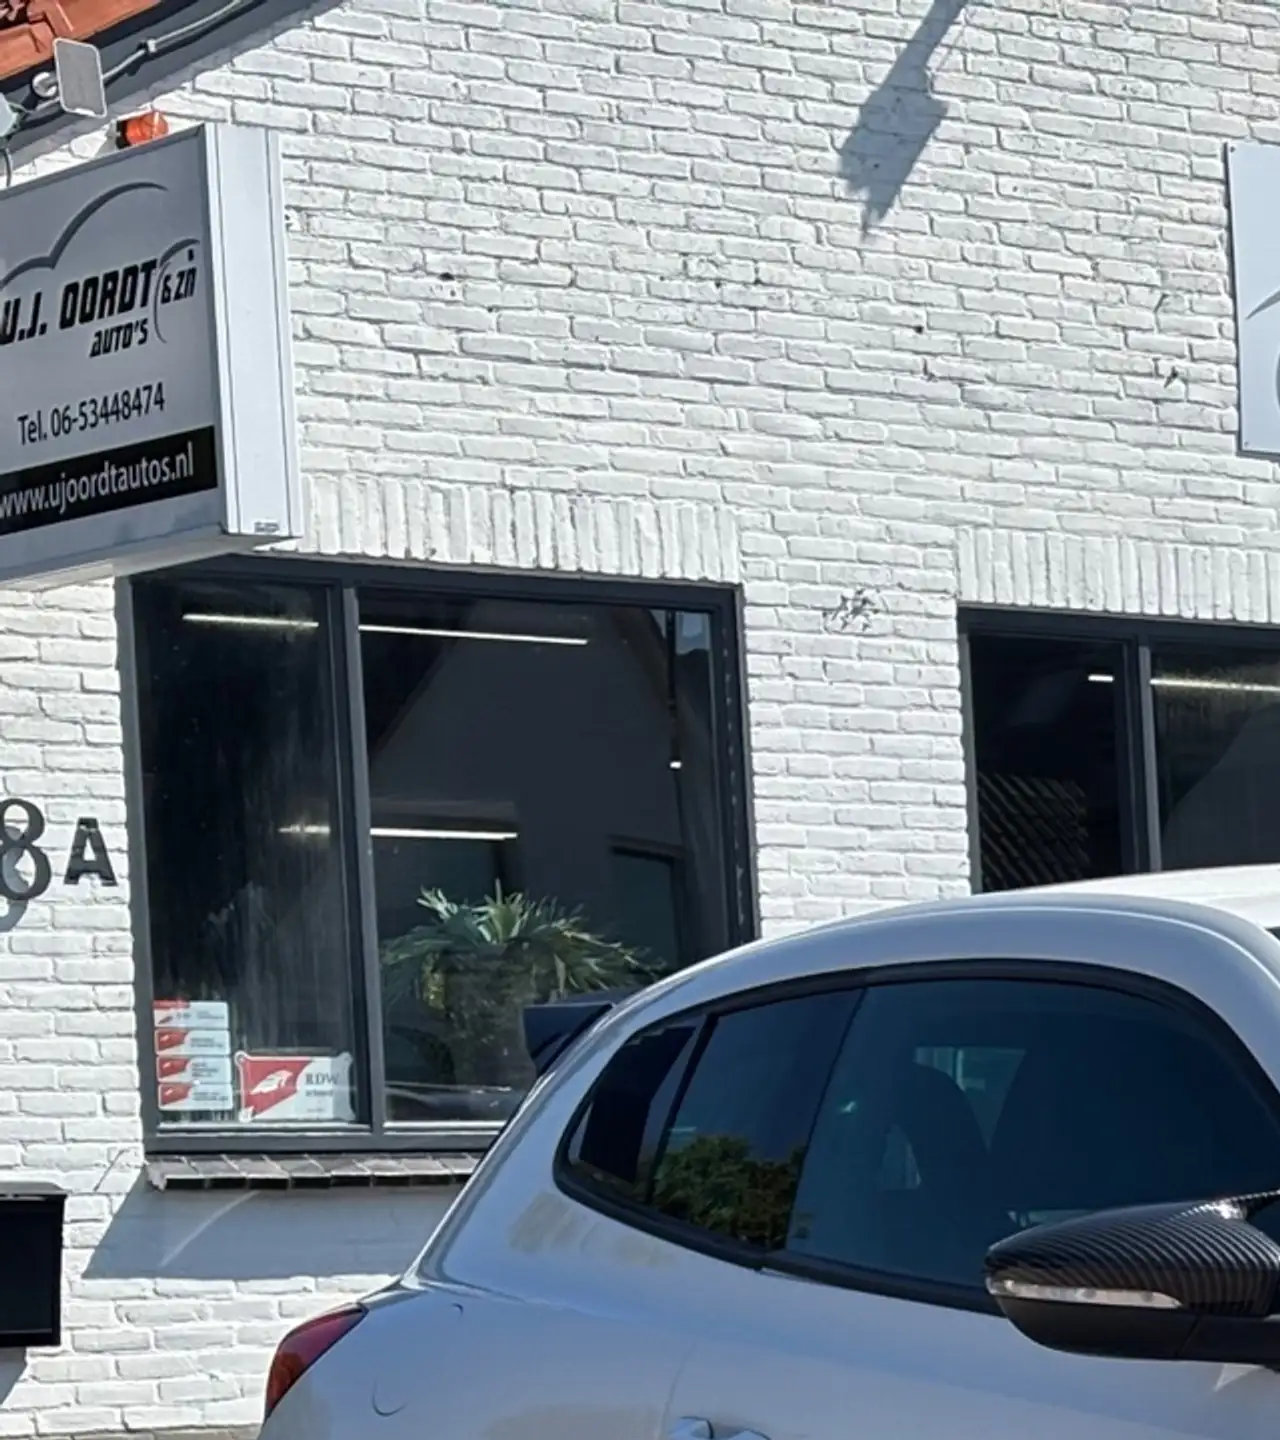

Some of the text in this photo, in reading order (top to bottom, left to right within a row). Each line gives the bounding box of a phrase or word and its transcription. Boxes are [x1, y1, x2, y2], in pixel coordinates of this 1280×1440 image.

[0, 291, 47, 346] U.J.
[59, 259, 157, 330] OORDT
[18, 381, 165, 446] Tel. 06-53448474
